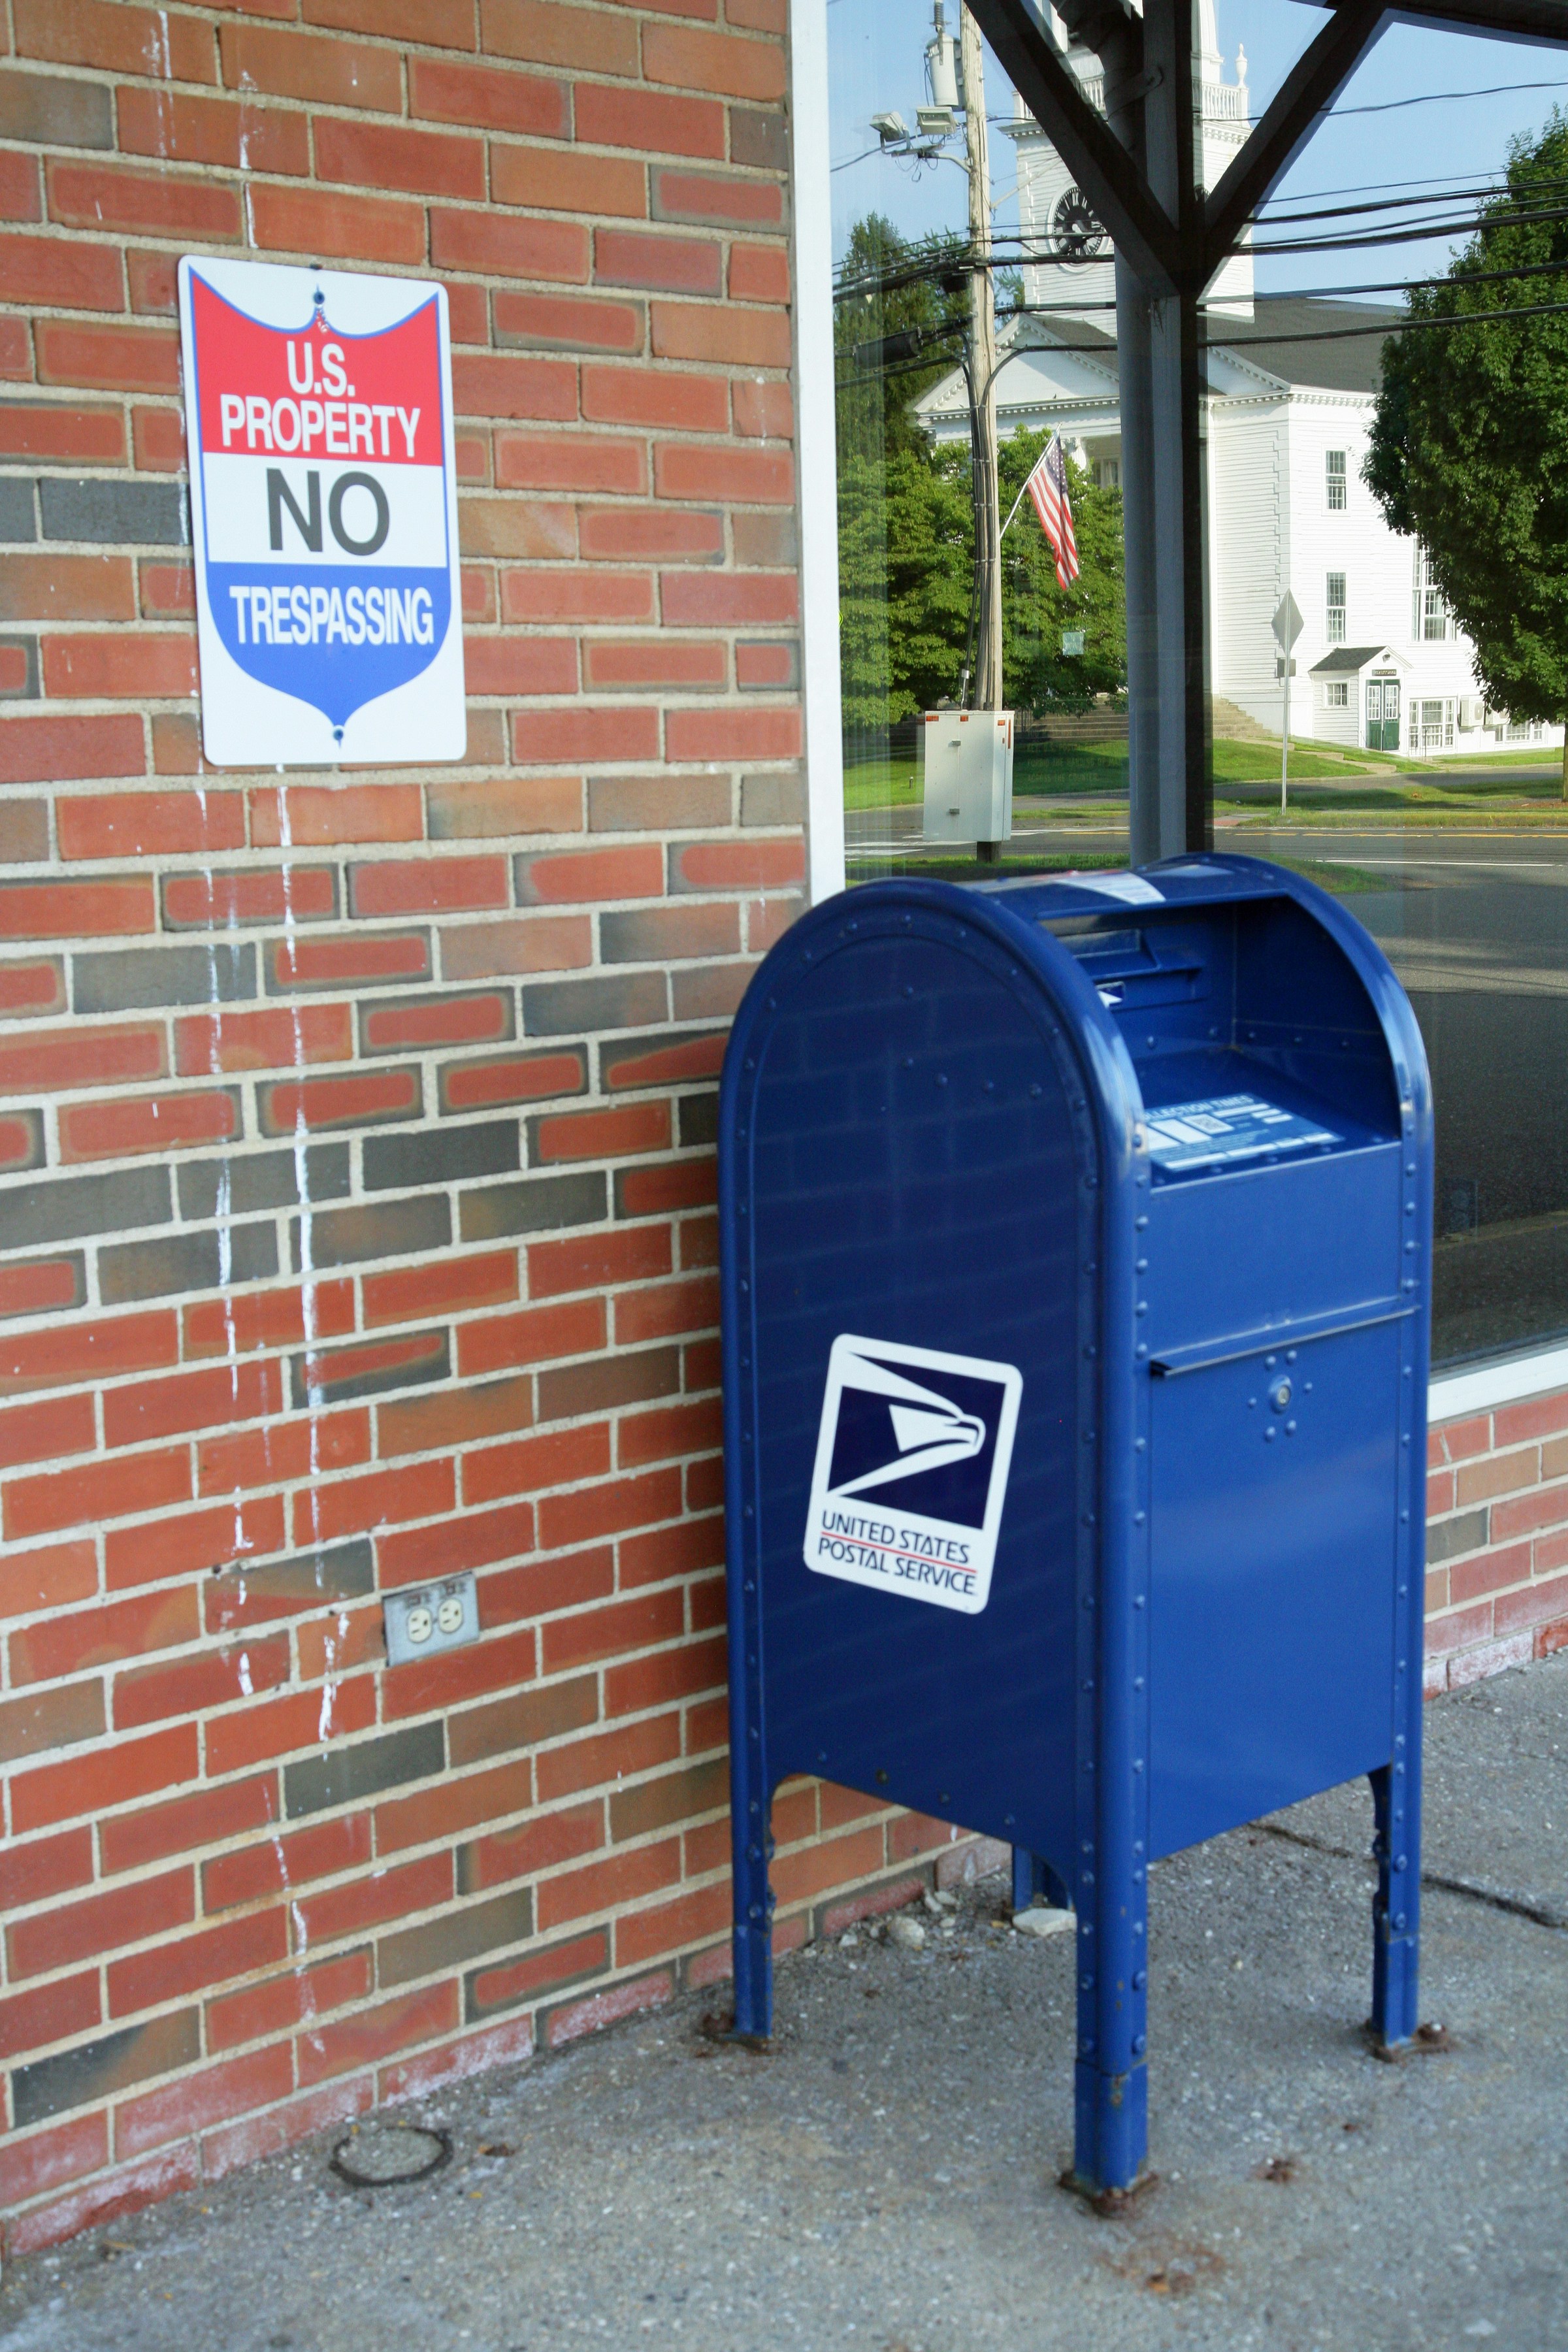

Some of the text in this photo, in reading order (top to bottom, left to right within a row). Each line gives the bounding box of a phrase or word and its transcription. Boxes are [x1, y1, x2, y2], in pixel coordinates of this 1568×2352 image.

[287, 341, 355, 396] U.S.
[220, 394, 421, 457] PROPERTY
[267, 468, 390, 557] NO
[230, 585, 434, 645] TRESPASSING
[1143, 1102, 1213, 1122] OLLECTION
[1210, 1094, 1254, 1109] TIMES
[818, 1537, 976, 1595] POSTAL SERVICE
[822, 1510, 970, 1564] UNITED STATES
